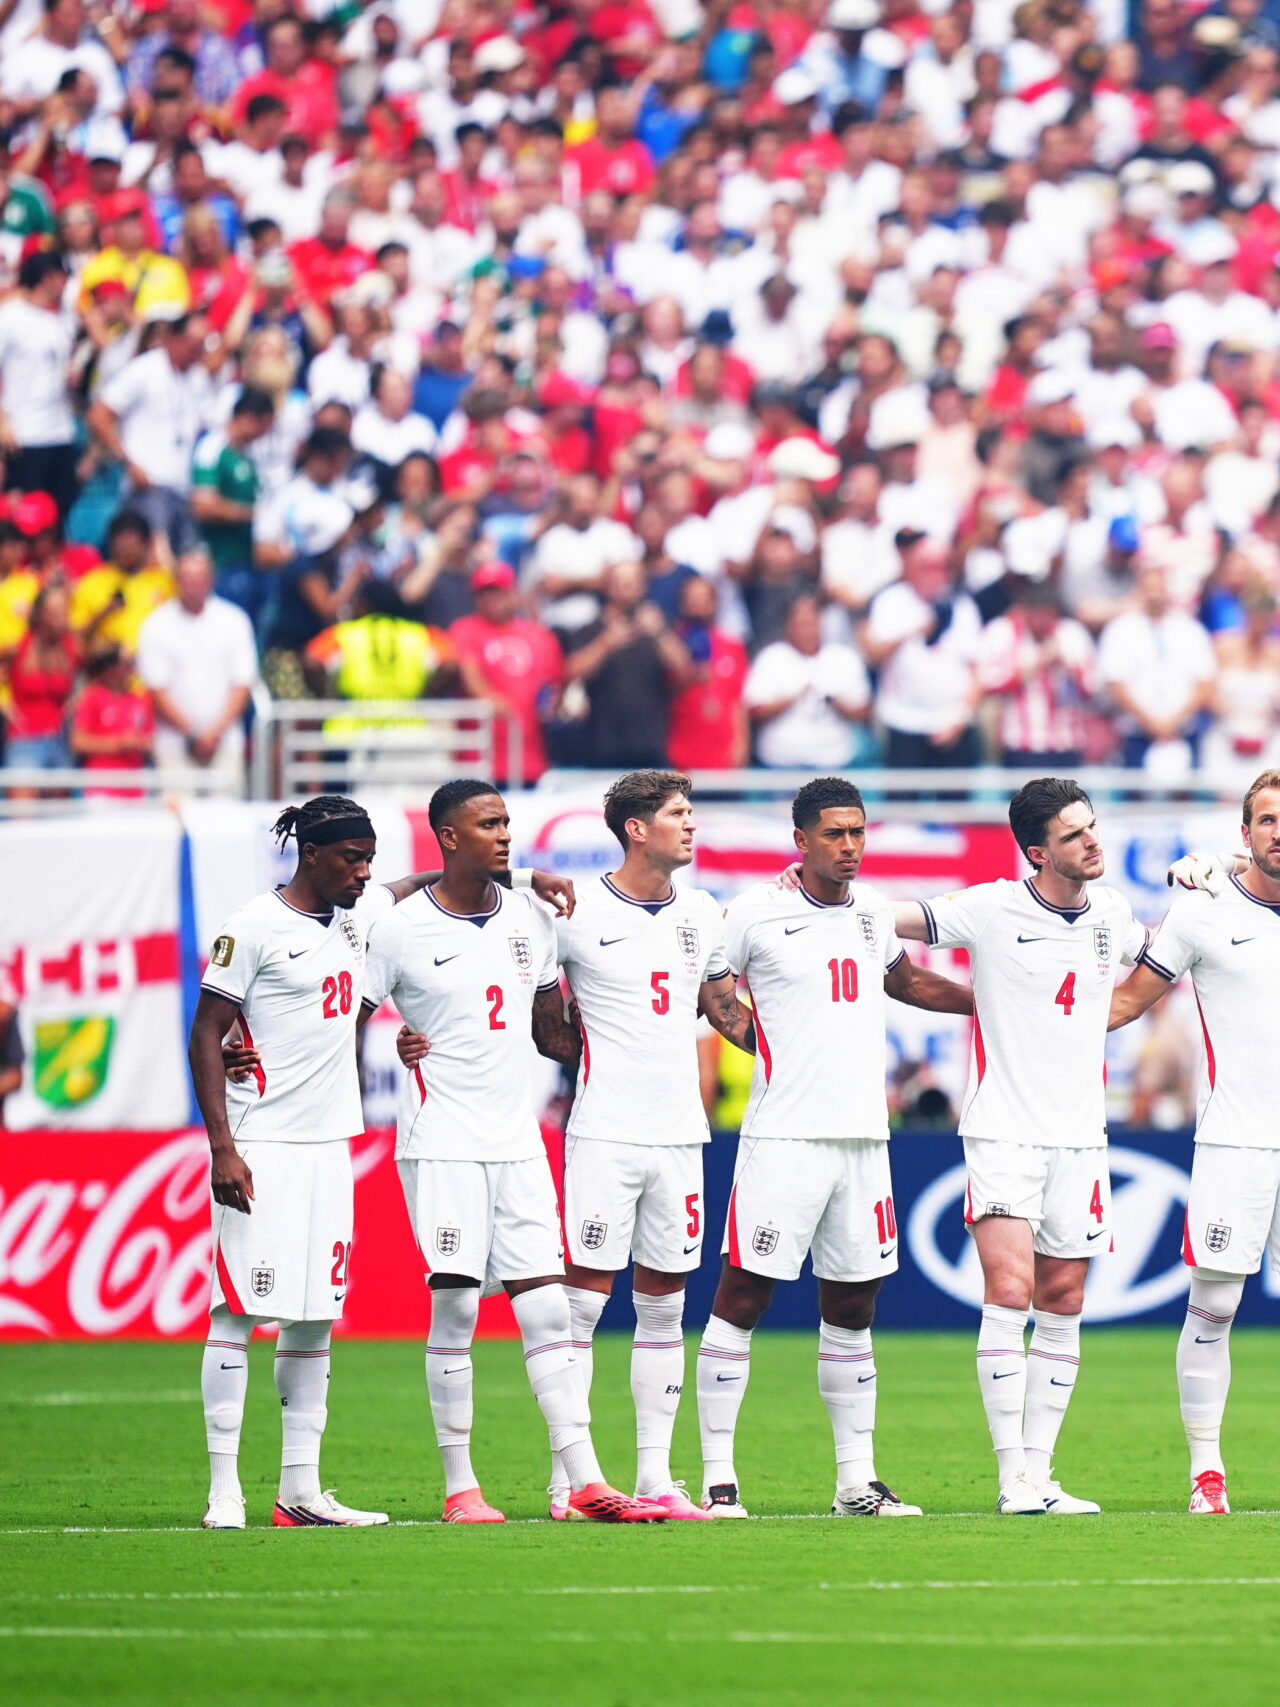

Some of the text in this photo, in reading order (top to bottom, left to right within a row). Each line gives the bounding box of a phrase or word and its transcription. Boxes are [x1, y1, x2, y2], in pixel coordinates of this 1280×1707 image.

[321, 970, 353, 1019] 20
[650, 971, 670, 1015] 5
[827, 958, 858, 1003] 10
[1055, 971, 1076, 1015] 4
[485, 984, 506, 1030] 2
[685, 1193, 700, 1238] 5
[873, 1196, 897, 1244] 10
[1089, 1180, 1104, 1223] 4
